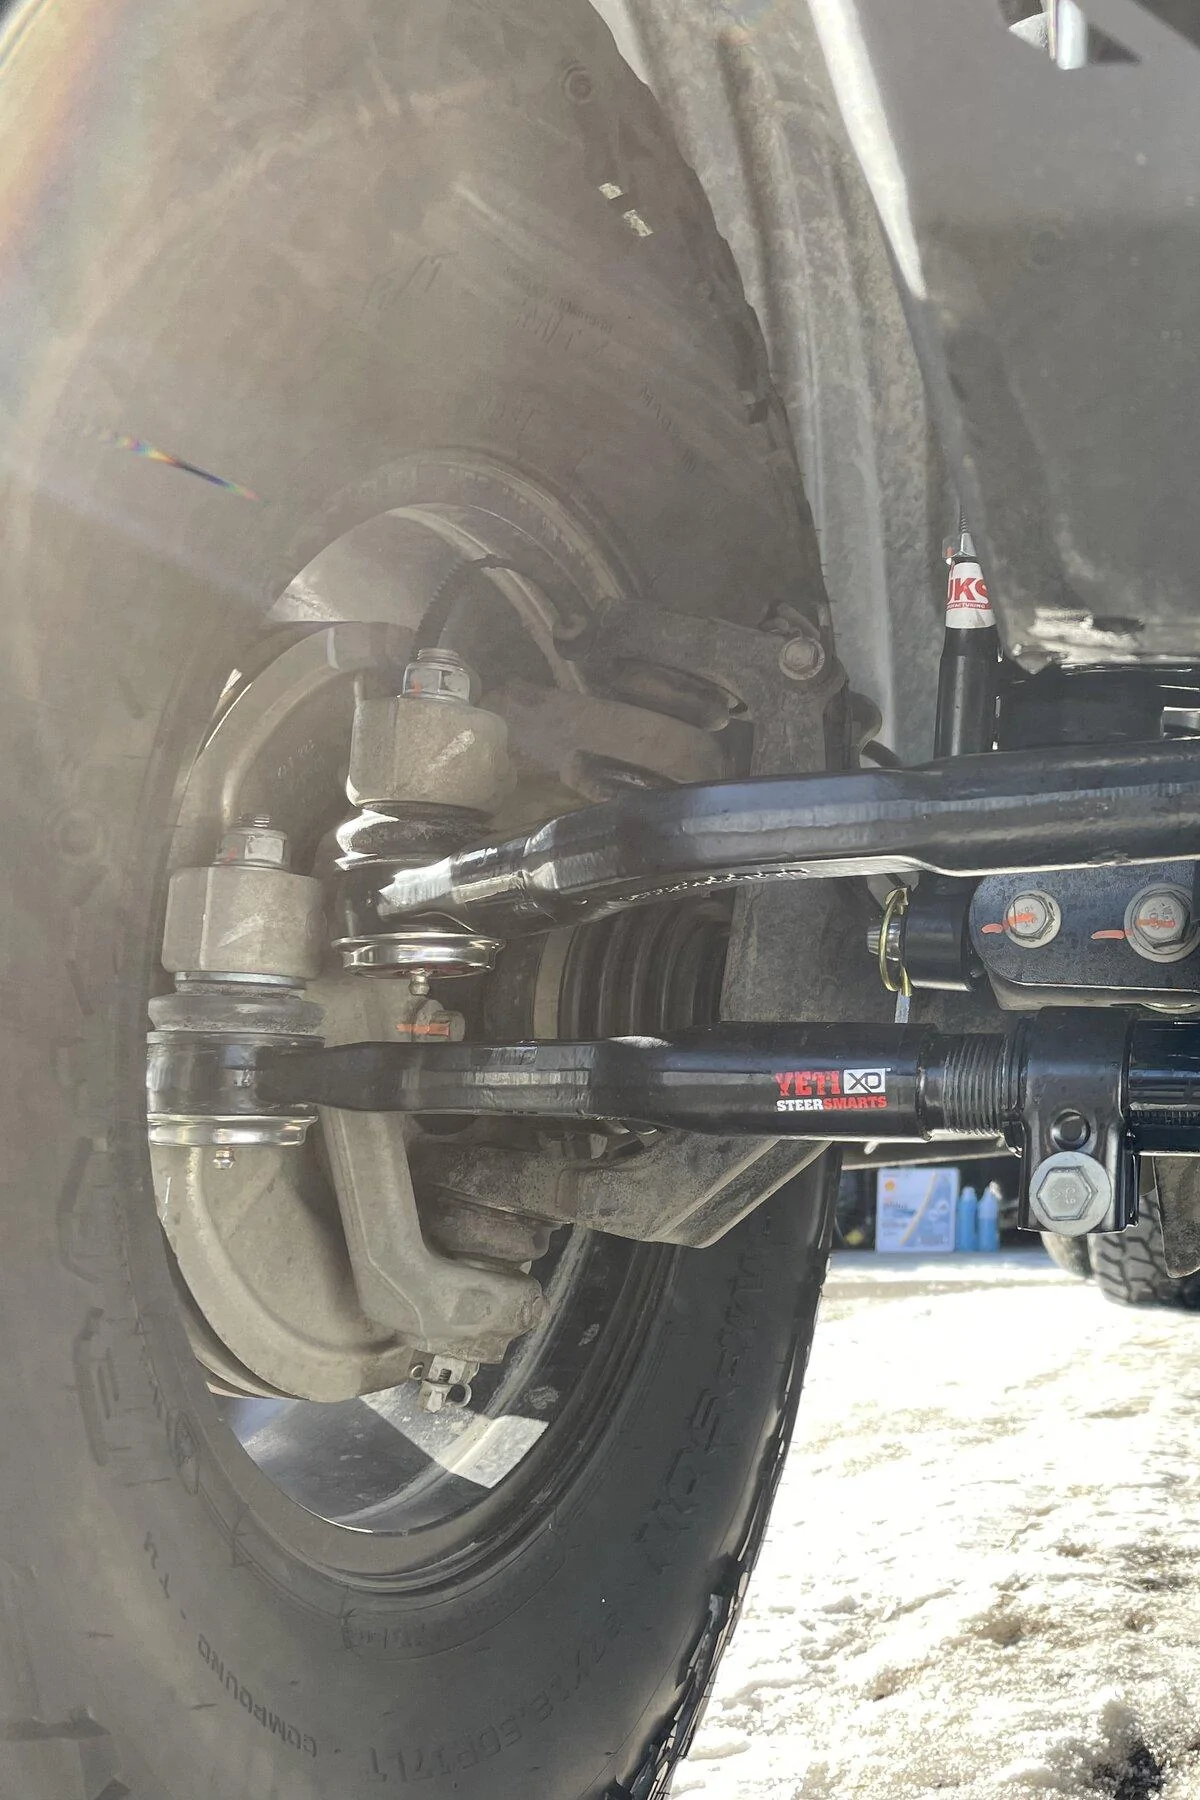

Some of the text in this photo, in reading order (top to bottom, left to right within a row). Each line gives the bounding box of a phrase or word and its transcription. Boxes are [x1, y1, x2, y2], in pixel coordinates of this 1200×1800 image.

[775, 1070, 840, 1096] YETI
[777, 1096, 887, 1112] STEERSMARTS
[198, 1634, 318, 1759] COMPOUND
